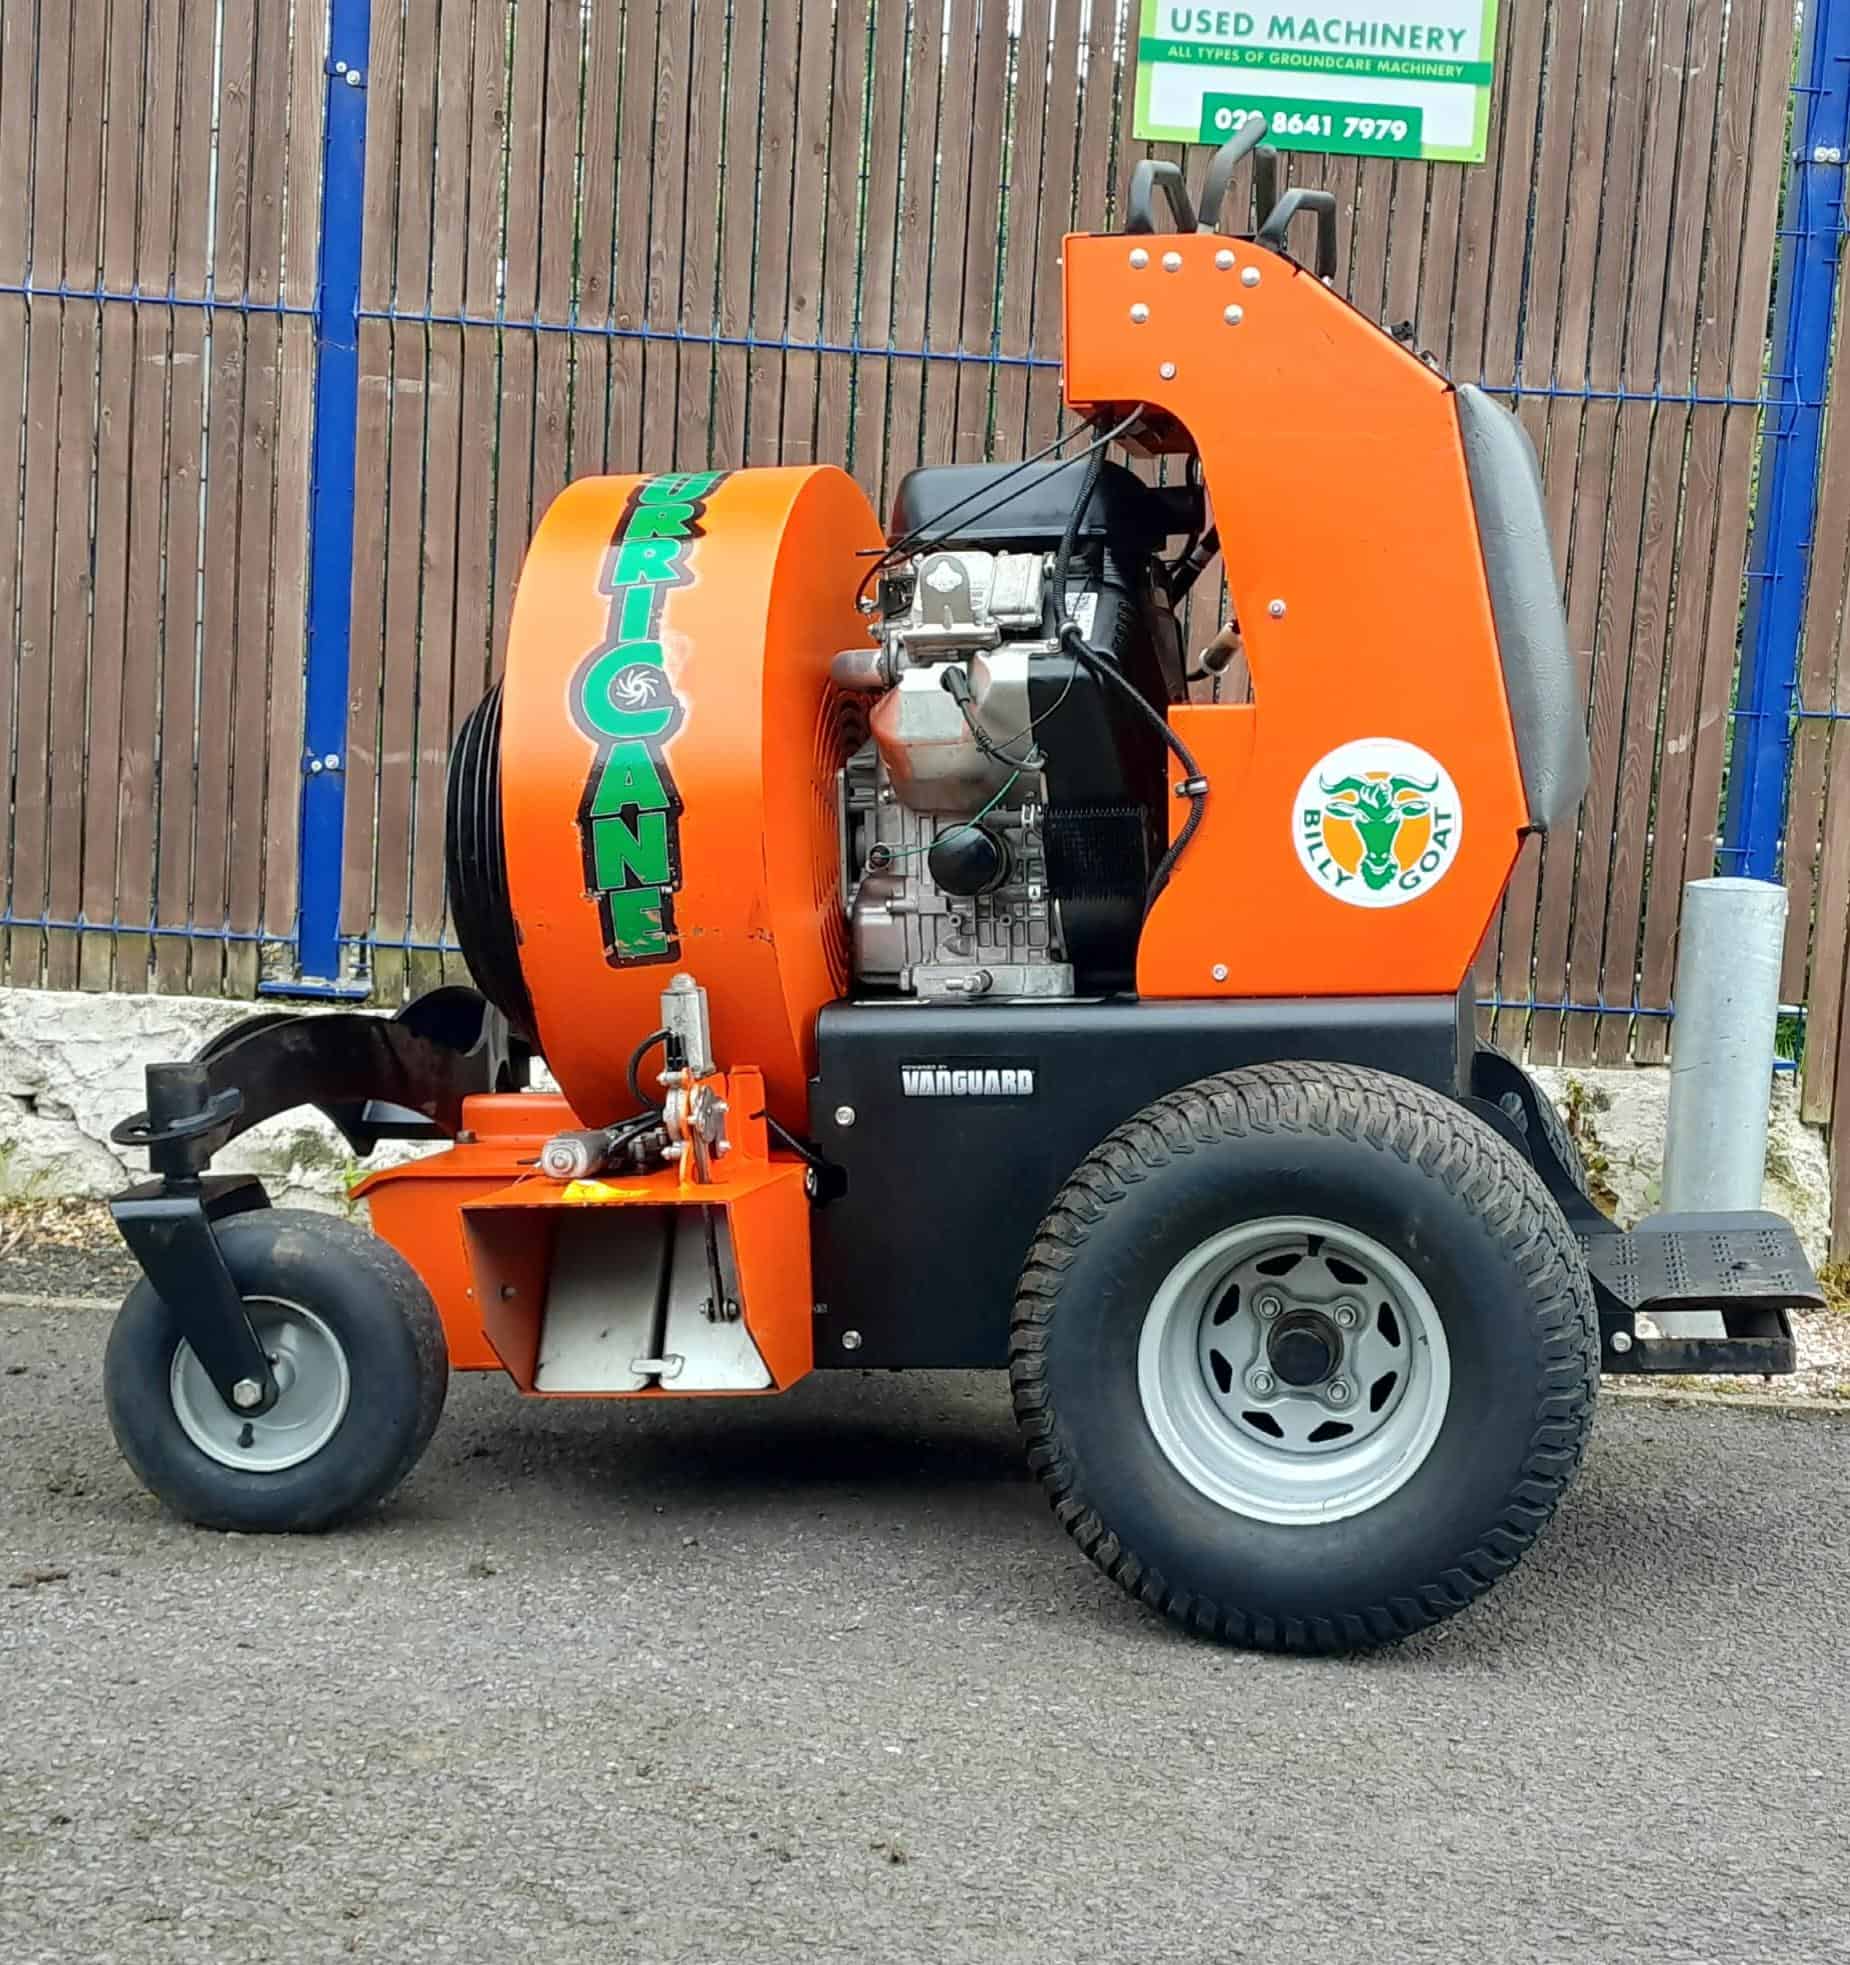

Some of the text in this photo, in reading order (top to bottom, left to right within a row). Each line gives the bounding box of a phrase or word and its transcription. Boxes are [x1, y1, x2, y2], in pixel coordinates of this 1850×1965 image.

[1170, 8, 1467, 50] USED MACHINERY
[1167, 46, 1464, 77] ALL TYPES OF GROUNDCARE MACHINERY
[1272, 111, 1332, 137] 8641
[1343, 117, 1407, 142] 7979
[1304, 807, 1452, 890] BILLY GOAT
[902, 1070, 1033, 1096] VANGUARD
